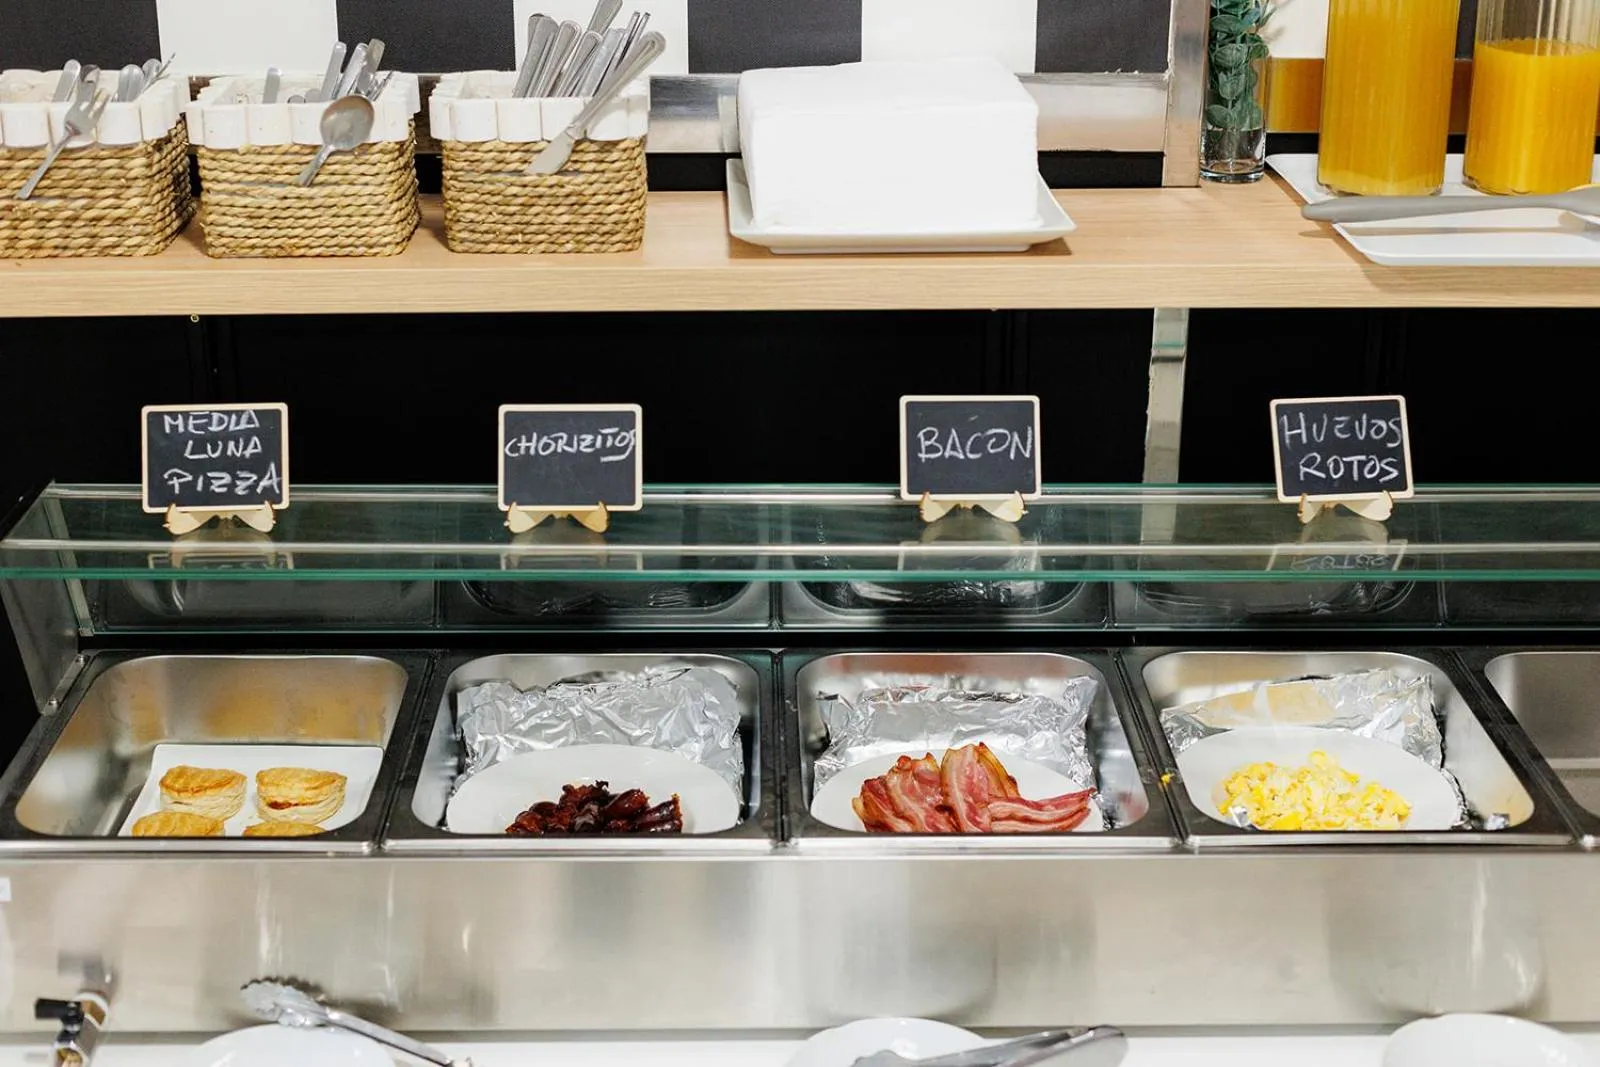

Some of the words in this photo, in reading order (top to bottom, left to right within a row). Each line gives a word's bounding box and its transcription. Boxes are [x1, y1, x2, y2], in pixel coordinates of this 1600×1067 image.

[163, 409, 260, 434] MEDIA
[1280, 412, 1402, 448] HUEVOS
[184, 436, 262, 459] LUNA
[504, 427, 637, 463] CHORIZITOS
[917, 426, 1033, 463] BACON
[163, 462, 282, 495] PIZZA
[1299, 452, 1399, 483] ROTOS
